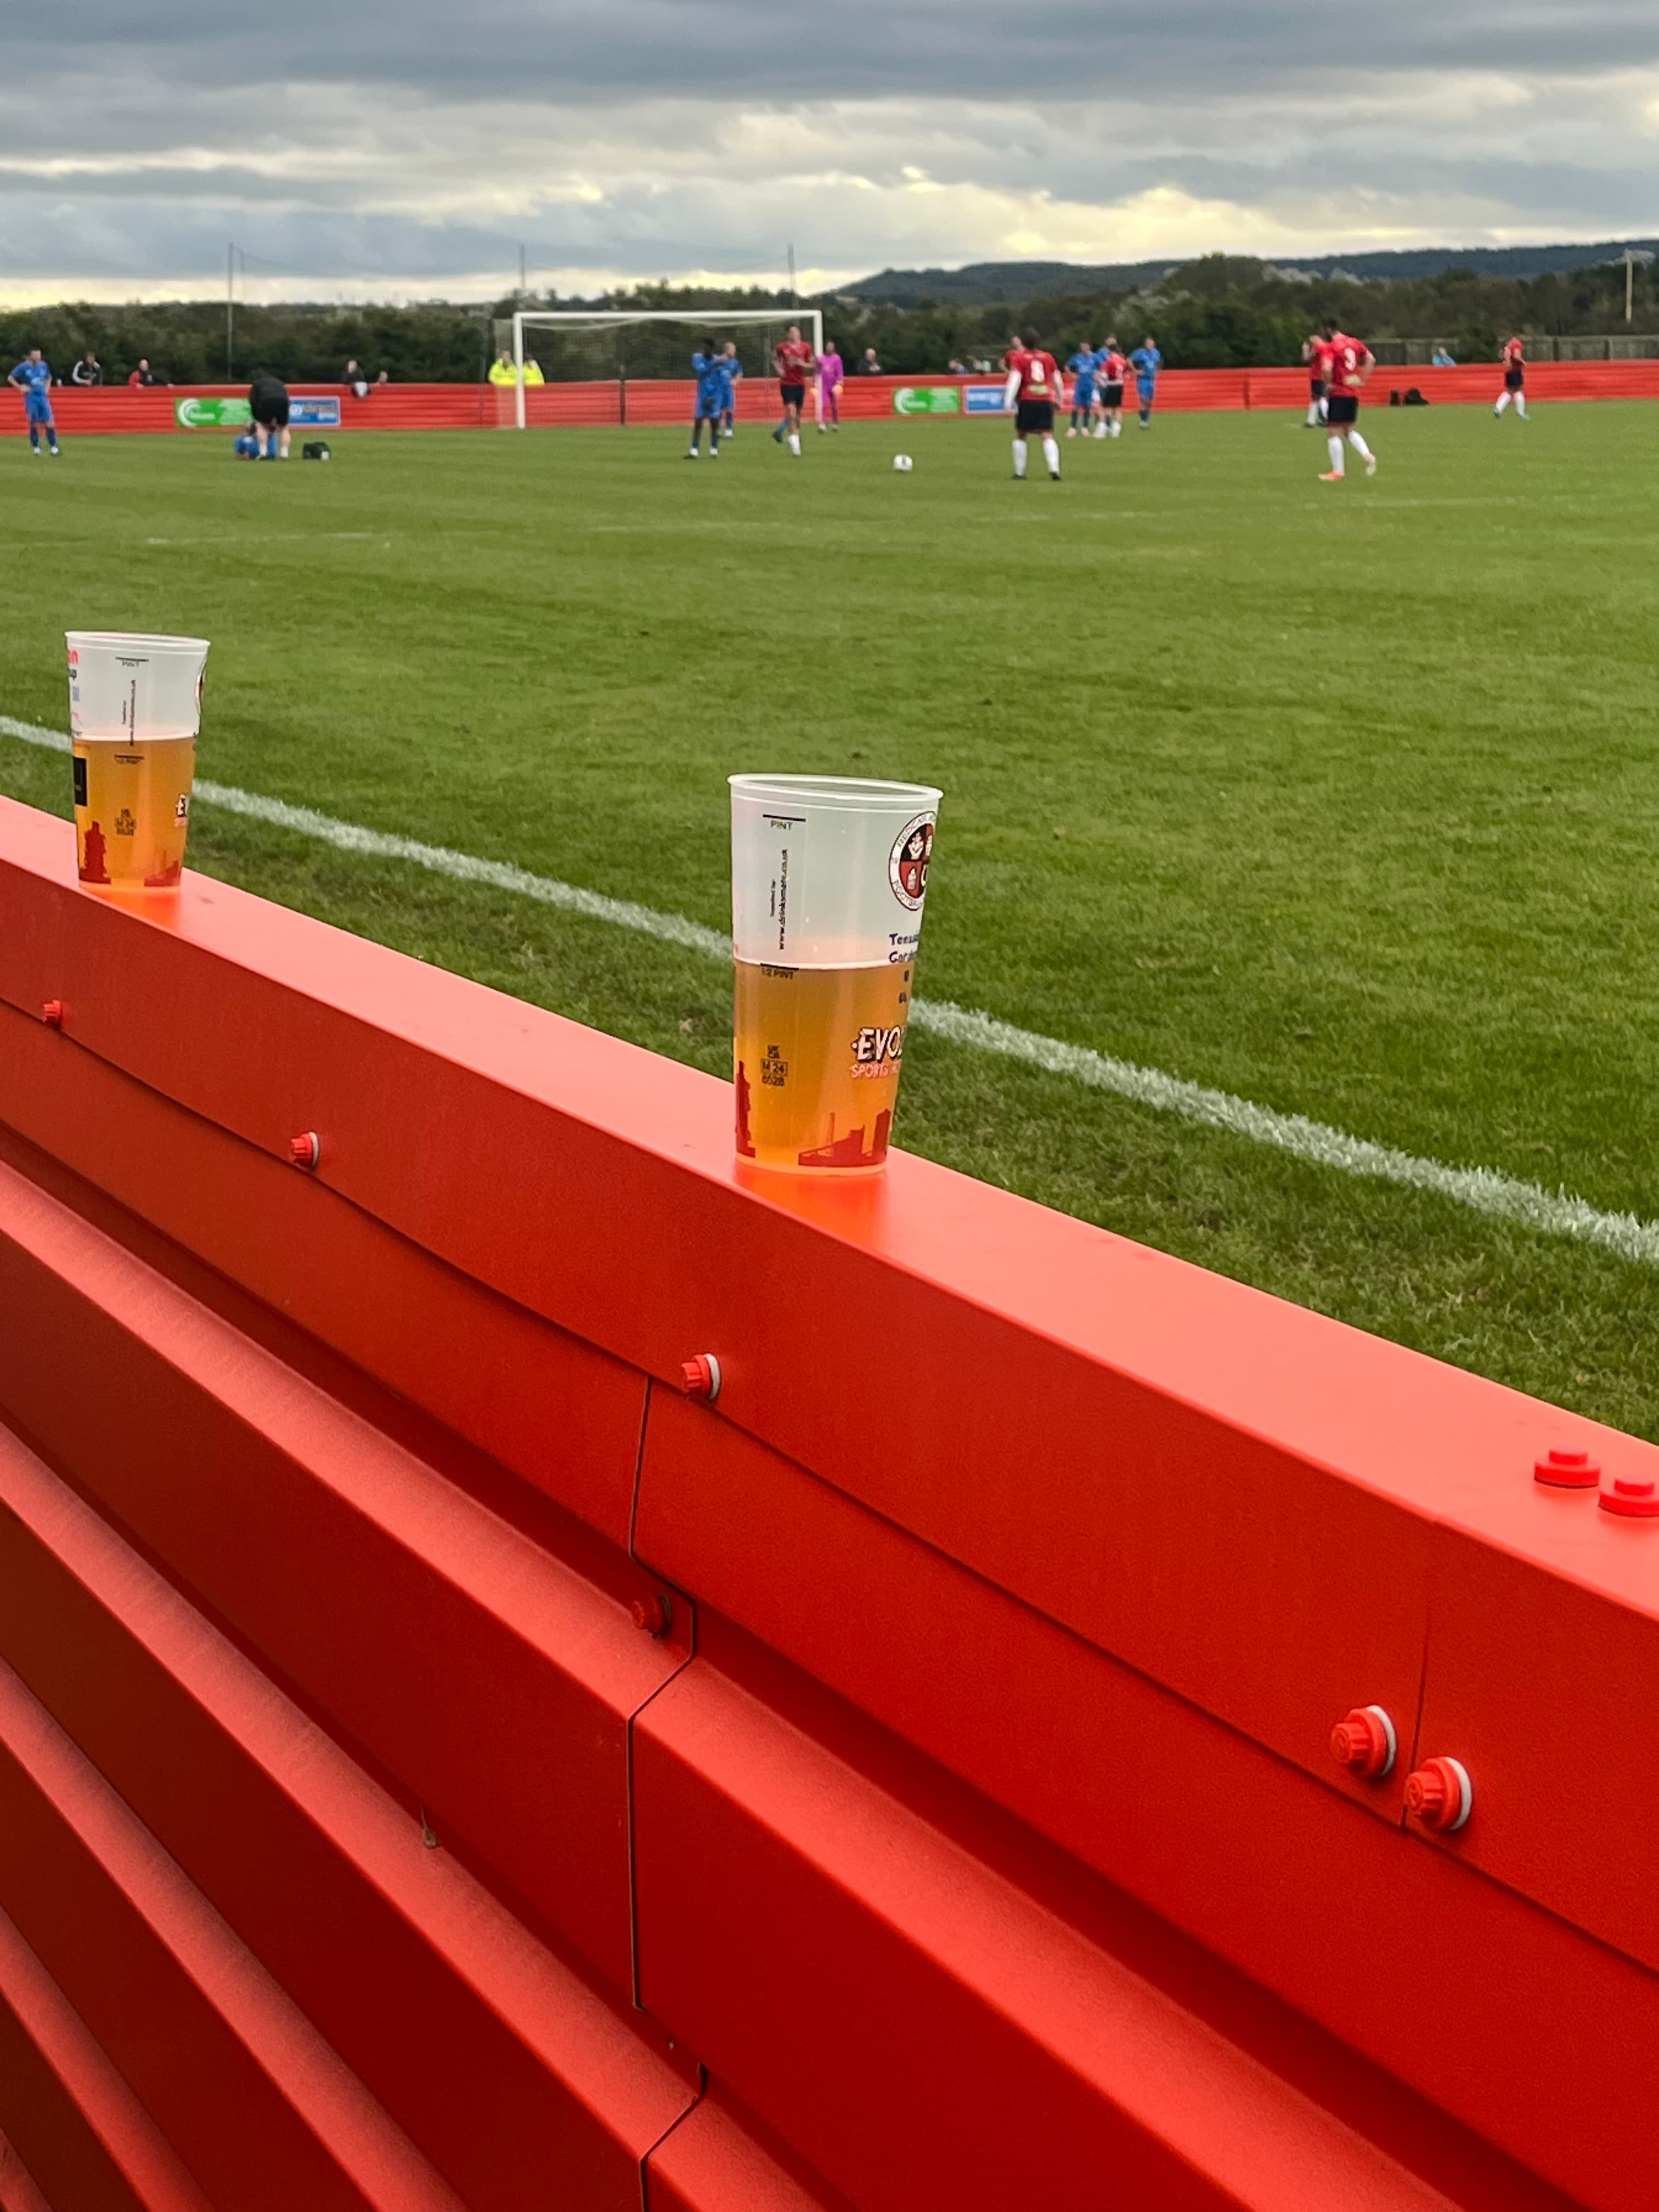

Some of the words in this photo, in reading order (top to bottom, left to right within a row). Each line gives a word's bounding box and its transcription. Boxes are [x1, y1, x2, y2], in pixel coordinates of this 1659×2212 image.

[770, 820, 793, 831] PINT
[773, 969, 794, 979] PINT
[850, 1064, 889, 1079] SPORTS
